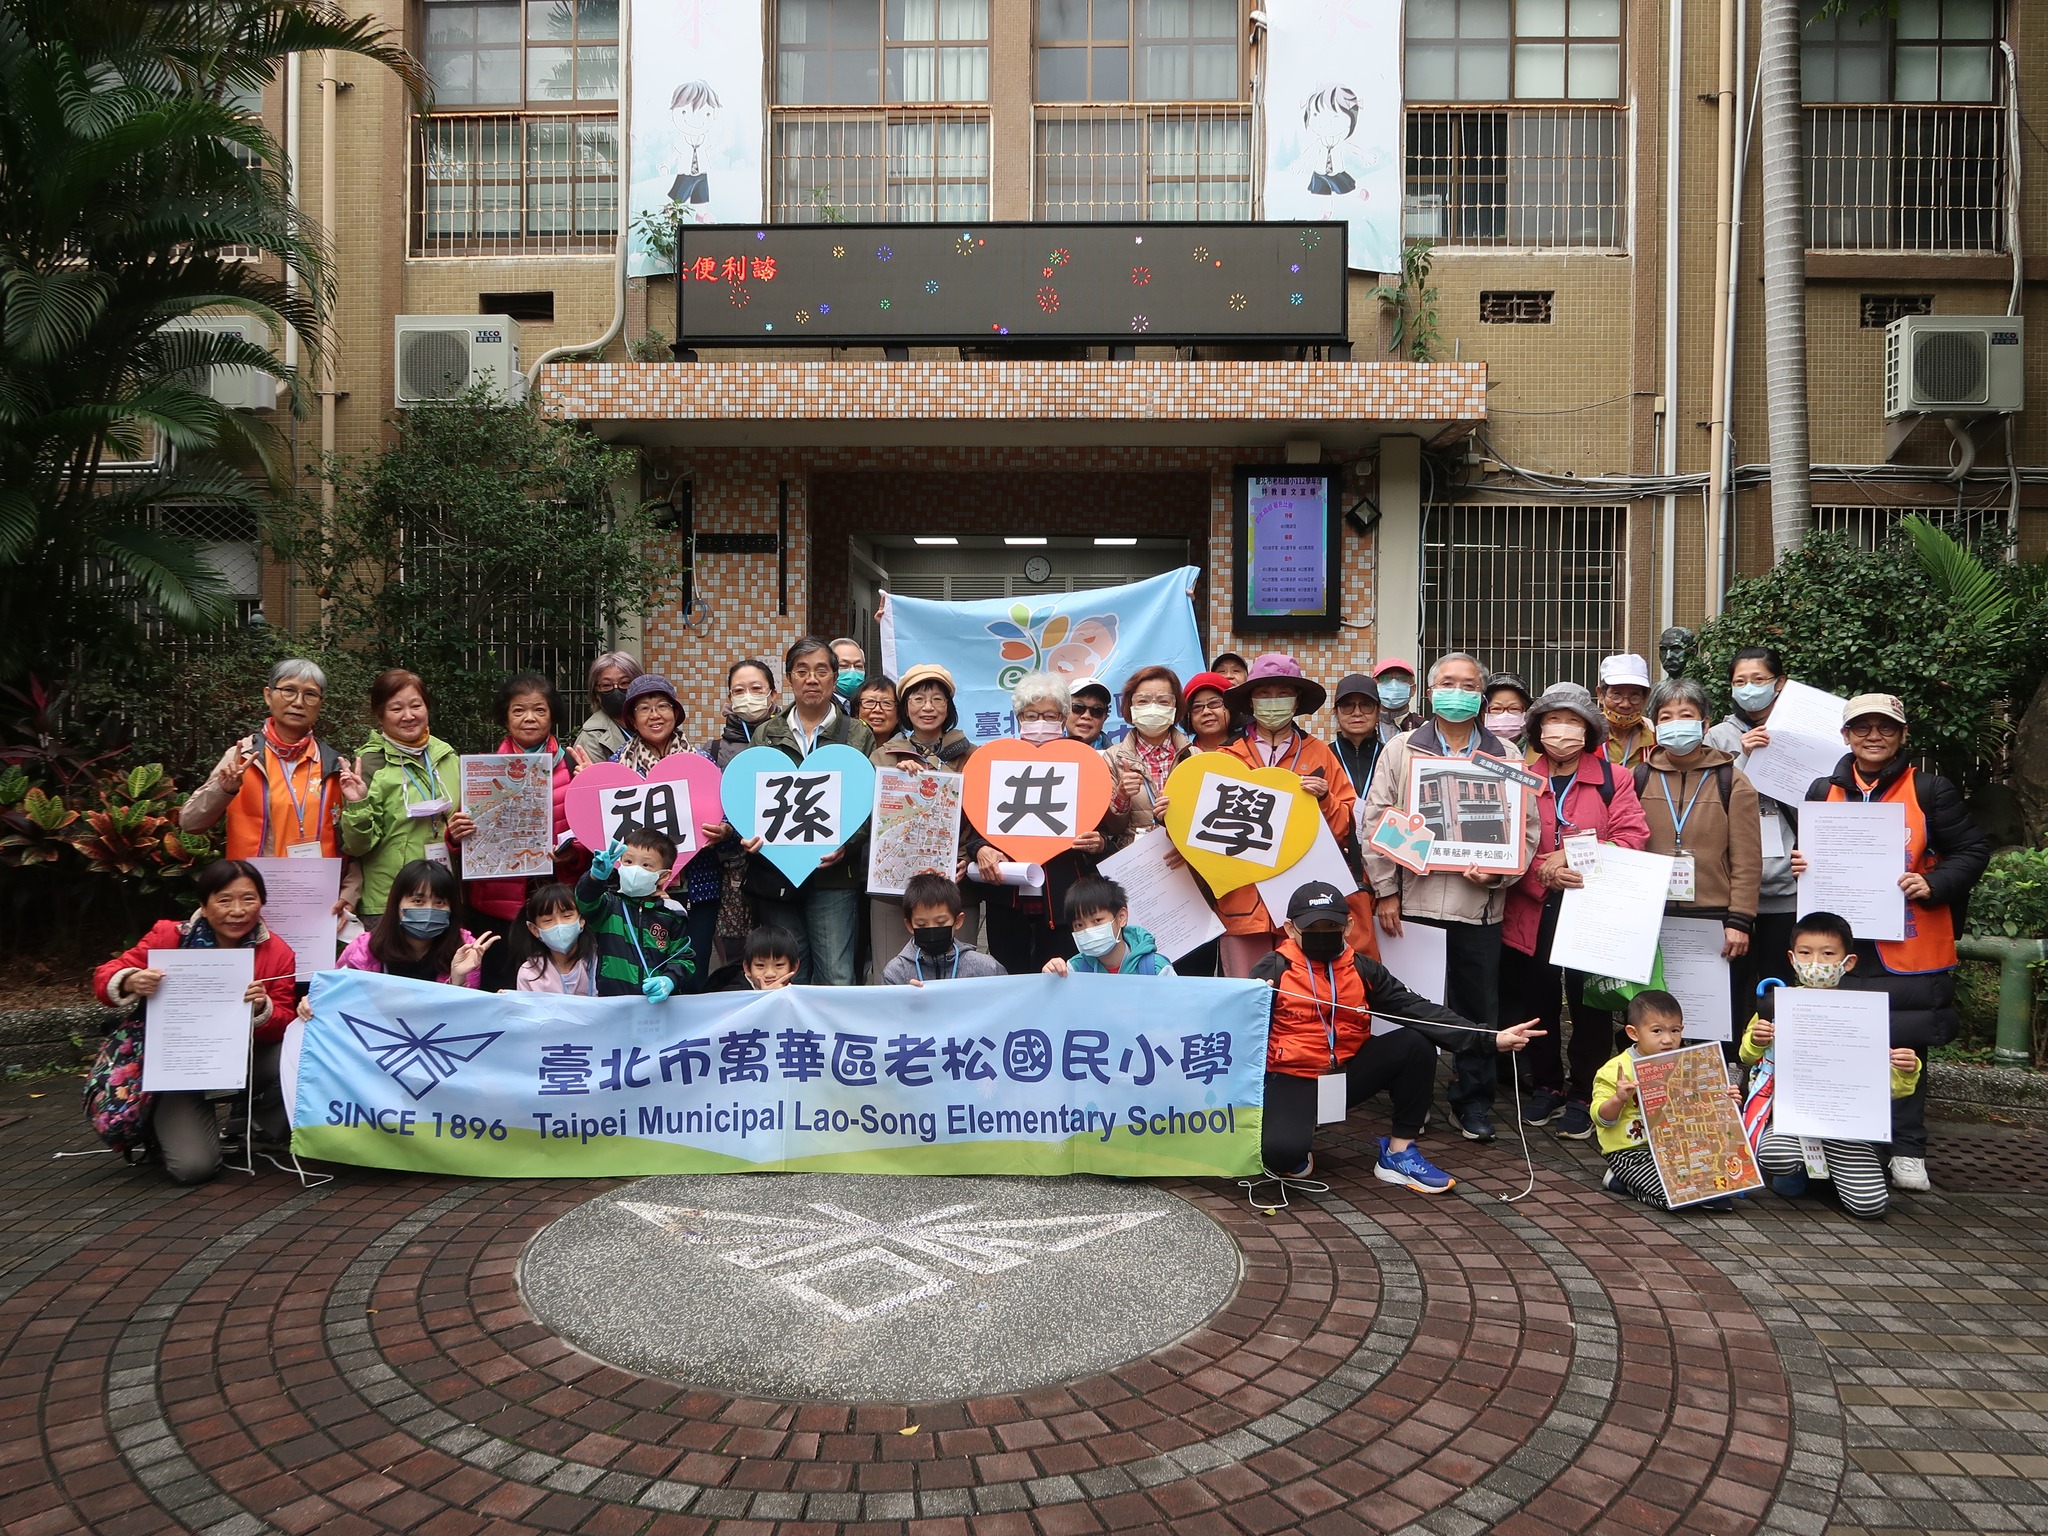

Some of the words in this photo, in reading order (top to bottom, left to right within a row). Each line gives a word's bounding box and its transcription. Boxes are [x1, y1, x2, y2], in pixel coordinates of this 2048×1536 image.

[682, 255, 777, 281] 便利諮
[611, 784, 687, 847] 祖
[761, 774, 835, 843] 孫
[996, 764, 1069, 836] 共
[1195, 782, 1277, 857] 學
[1474, 849, 1513, 861] 老松國小
[650, 923, 668, 941] 69
[538, 1028, 1233, 1096] 臺北市萬華區老松國民小學
[326, 1100, 417, 1136] SINCE
[432, 1112, 508, 1141] 1896
[532, 1108, 627, 1145] Taipei
[639, 1099, 783, 1139] Municipal
[795, 1101, 936, 1143] Lao-Song
[947, 1103, 1117, 1142] Elementary
[1127, 1103, 1235, 1135] School
